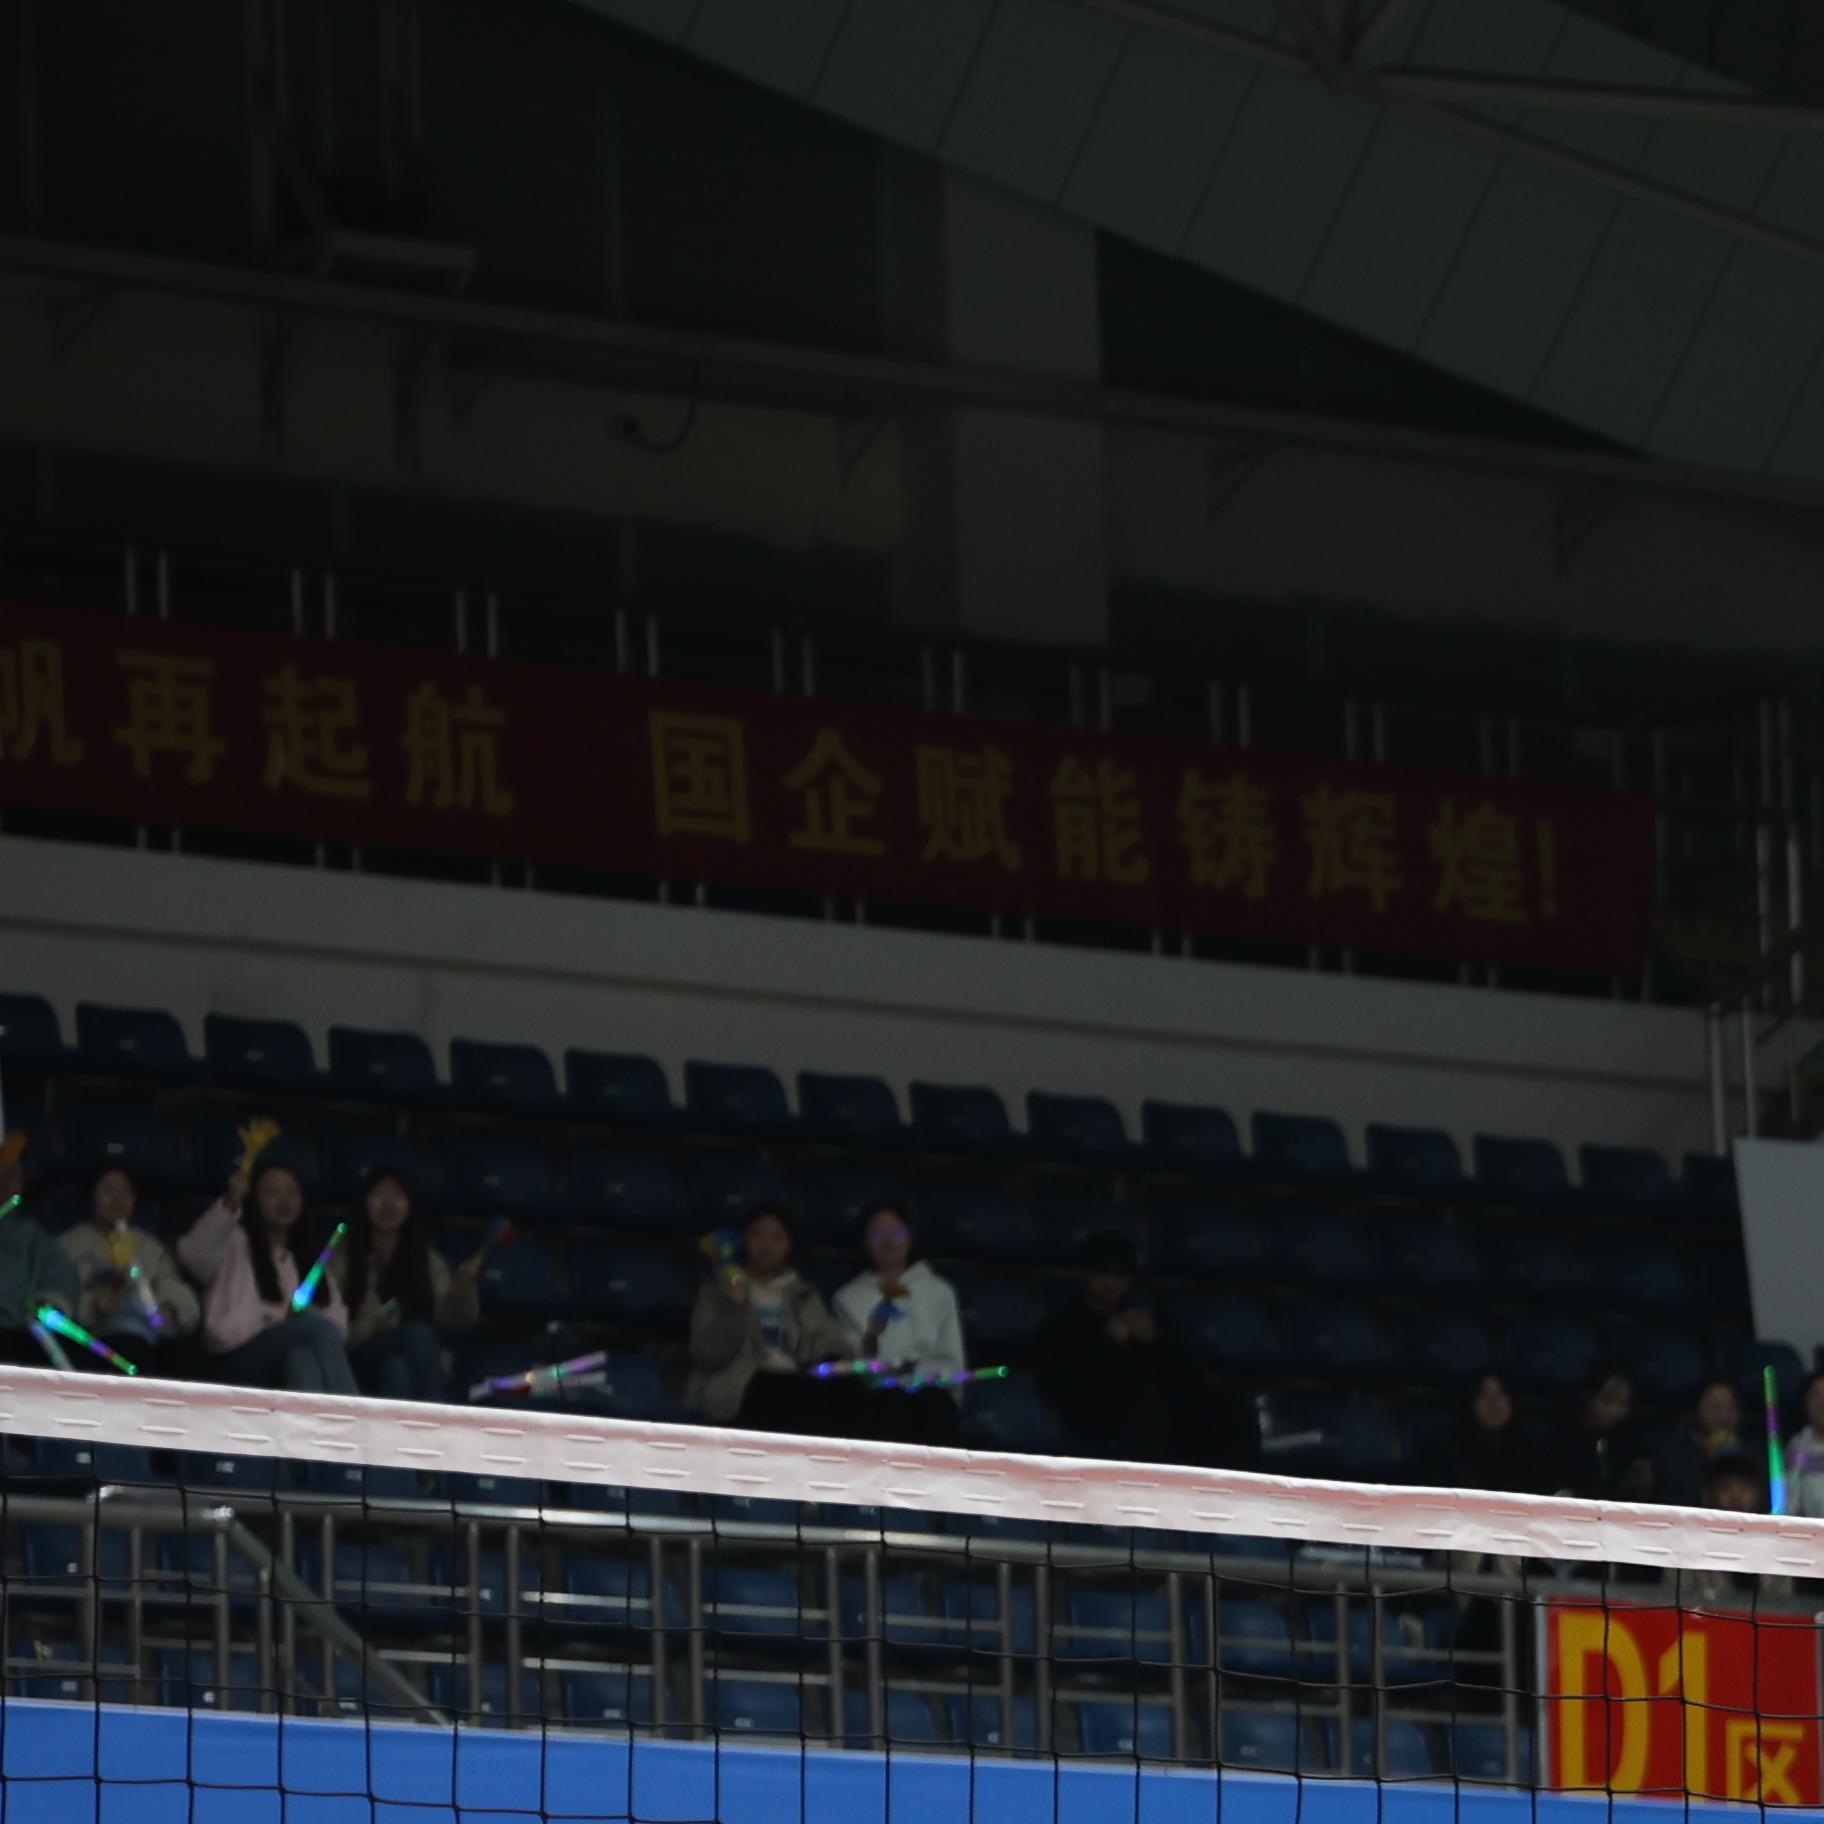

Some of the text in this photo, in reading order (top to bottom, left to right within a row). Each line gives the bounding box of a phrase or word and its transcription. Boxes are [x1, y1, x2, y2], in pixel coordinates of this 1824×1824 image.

[648, 708, 1557, 924] 国企赋能铸辉煌!
[1558, 1611, 1806, 1806] D1区
